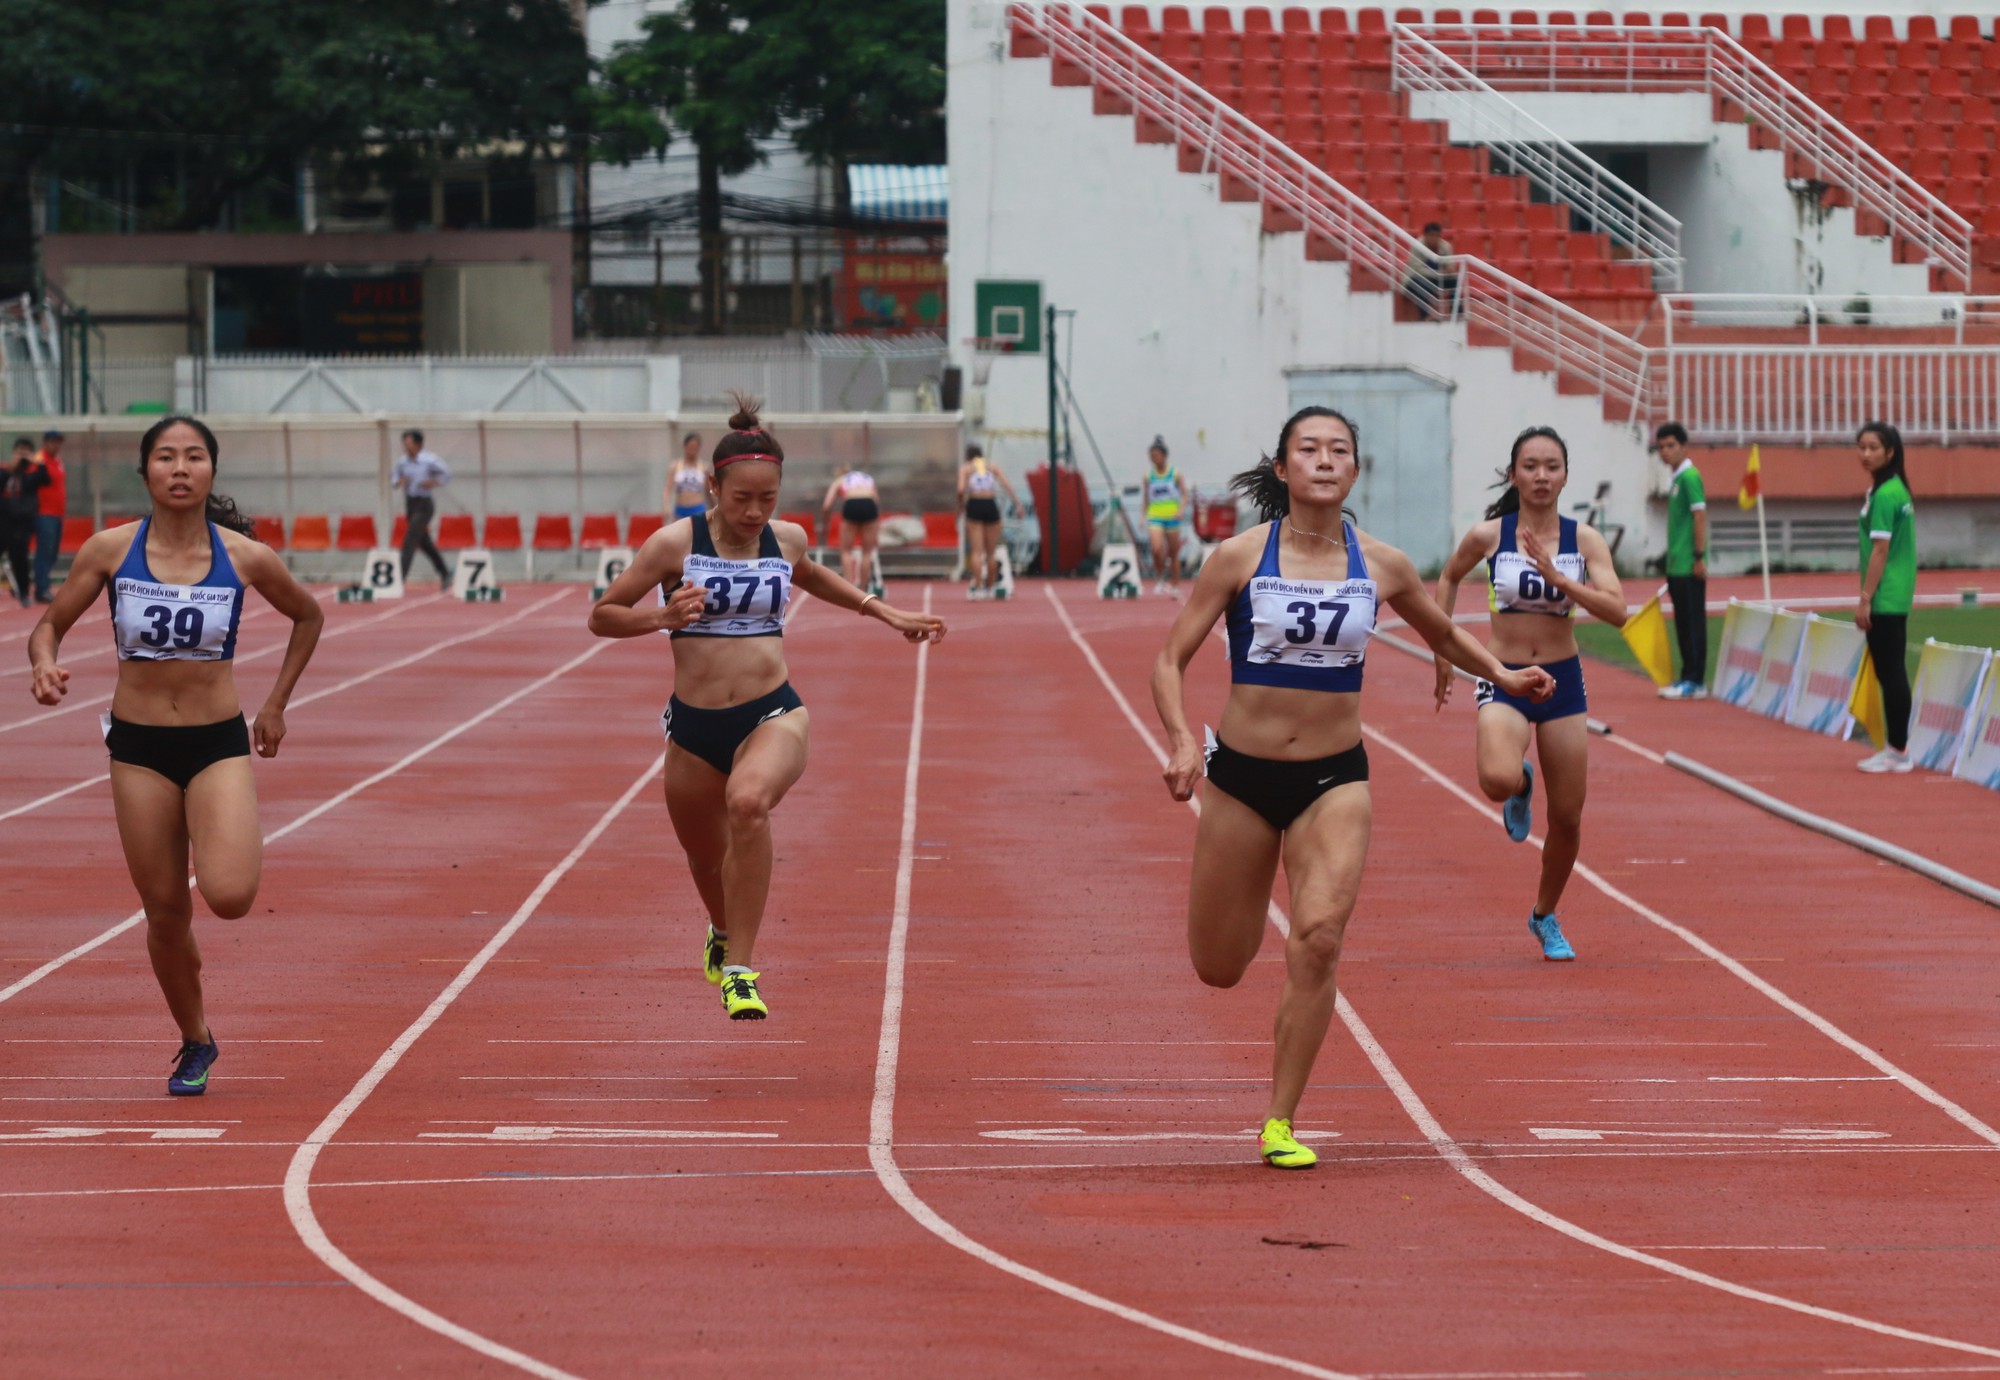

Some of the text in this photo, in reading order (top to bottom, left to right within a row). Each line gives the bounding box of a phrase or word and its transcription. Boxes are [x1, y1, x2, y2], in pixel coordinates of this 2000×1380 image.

[371, 560, 395, 588] 8
[463, 561, 487, 587] 7
[1109, 559, 1131, 585] 2
[164, 590, 180, 599] KINH
[703, 575, 782, 616] 371
[1308, 586, 1324, 596] KINH
[140, 604, 205, 650] 39
[1285, 601, 1350, 646] 37
